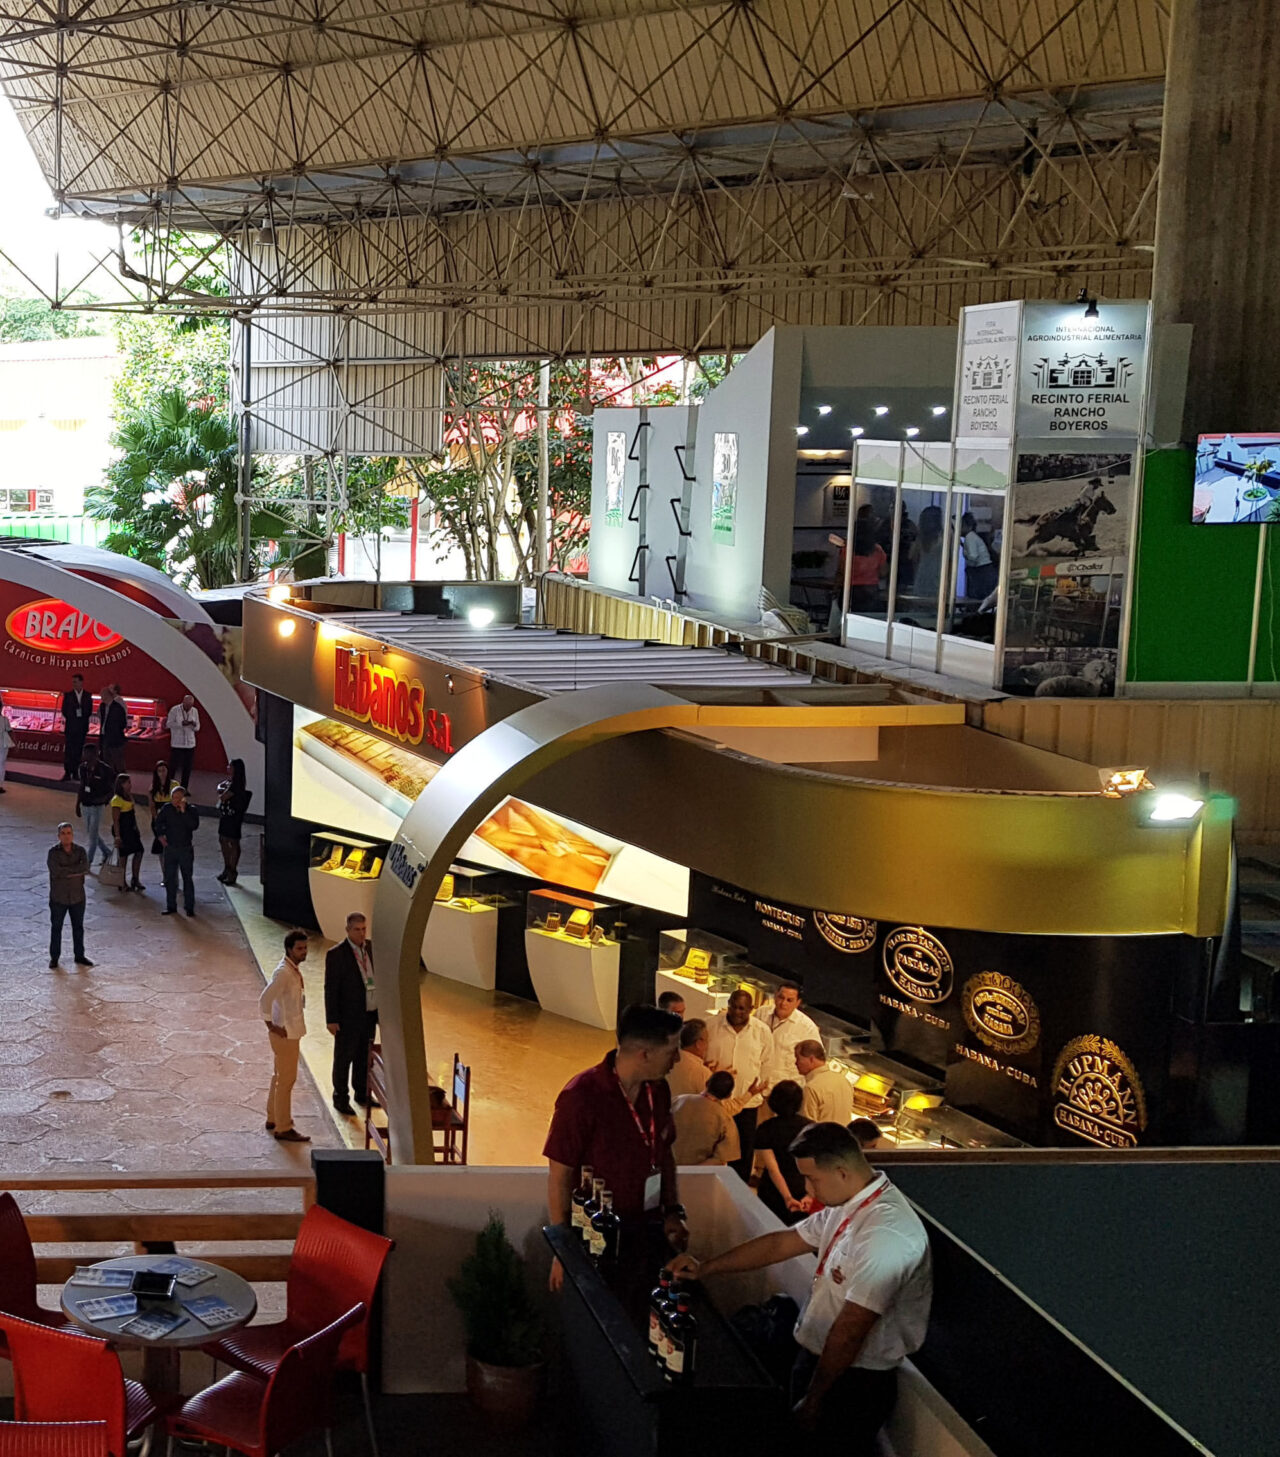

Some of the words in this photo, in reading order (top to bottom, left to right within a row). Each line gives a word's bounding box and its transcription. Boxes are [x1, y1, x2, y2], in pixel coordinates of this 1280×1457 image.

[1056, 325, 1115, 333] INTERNACIONAL
[1027, 334, 1092, 342] AGROINDUSTRIAL
[1094, 333, 1142, 341] ALIMENTARIA
[963, 395, 988, 405] RECINTO
[989, 394, 1009, 404] FERIAL
[1031, 394, 1083, 404] RECINTO
[1088, 393, 1130, 403] FERIAL
[973, 407, 998, 417] RANCHO
[1054, 407, 1106, 417] RANCHO
[970, 421, 998, 431] BOYEROS
[1049, 420, 1108, 431] BOYEROS
[4, 640, 46, 665] Cárnicos
[50, 646, 131, 670] Hispano-Cubanos
[334, 645, 424, 742] Habanos
[897, 953, 939, 977] PARTAGAS
[899, 975, 936, 998] HABANA
[879, 994, 918, 1018] HABANA
[924, 1013, 951, 1030] CUBA
[955, 1043, 999, 1071] HABANA
[1006, 1066, 1038, 1089] CUBA
[1059, 1108, 1100, 1137] HABANA
[1104, 1130, 1131, 1148] CUBA
